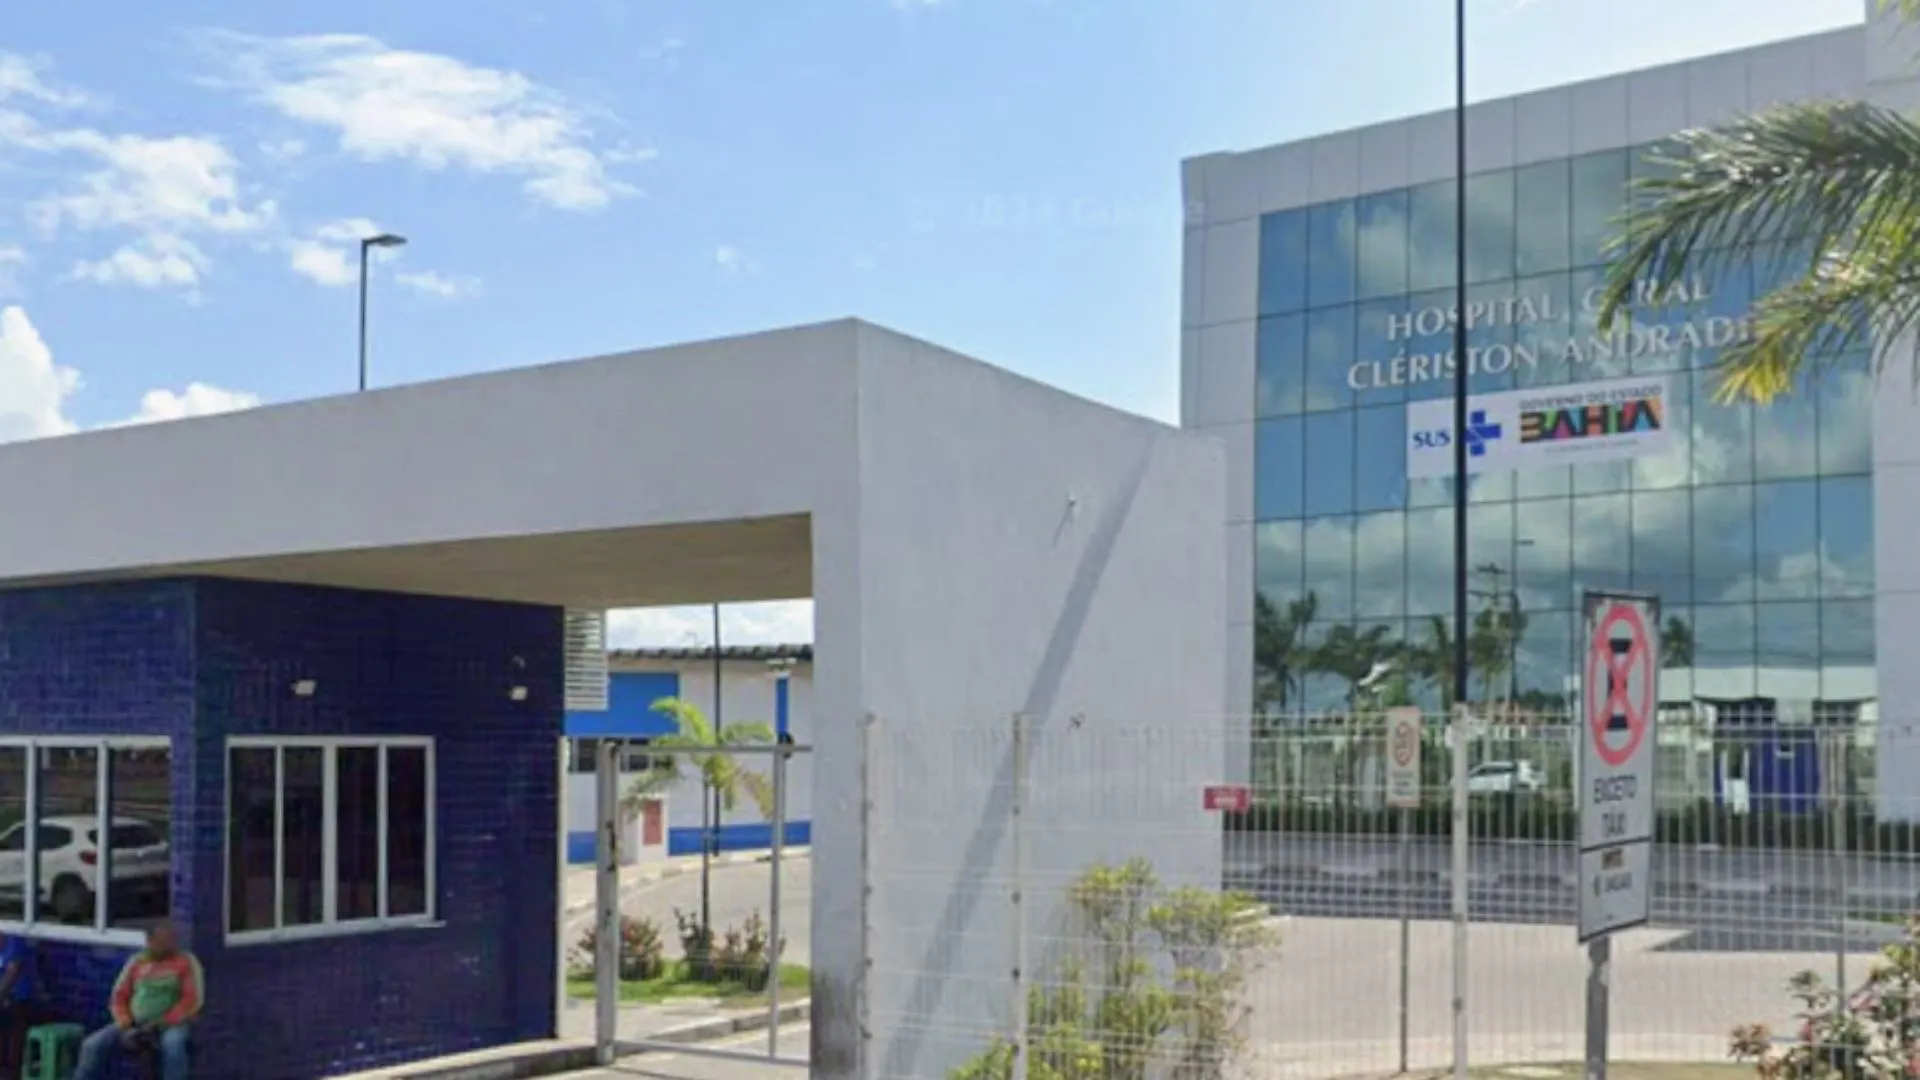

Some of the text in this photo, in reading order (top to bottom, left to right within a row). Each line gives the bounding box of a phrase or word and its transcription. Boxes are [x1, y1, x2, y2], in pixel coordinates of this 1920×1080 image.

[1386, 293, 1558, 341] HOSPITAL
[1347, 343, 1540, 390] CLÉRISTON
[1412, 428, 1451, 448] SUS
[1520, 398, 1661, 443] BAHIA
